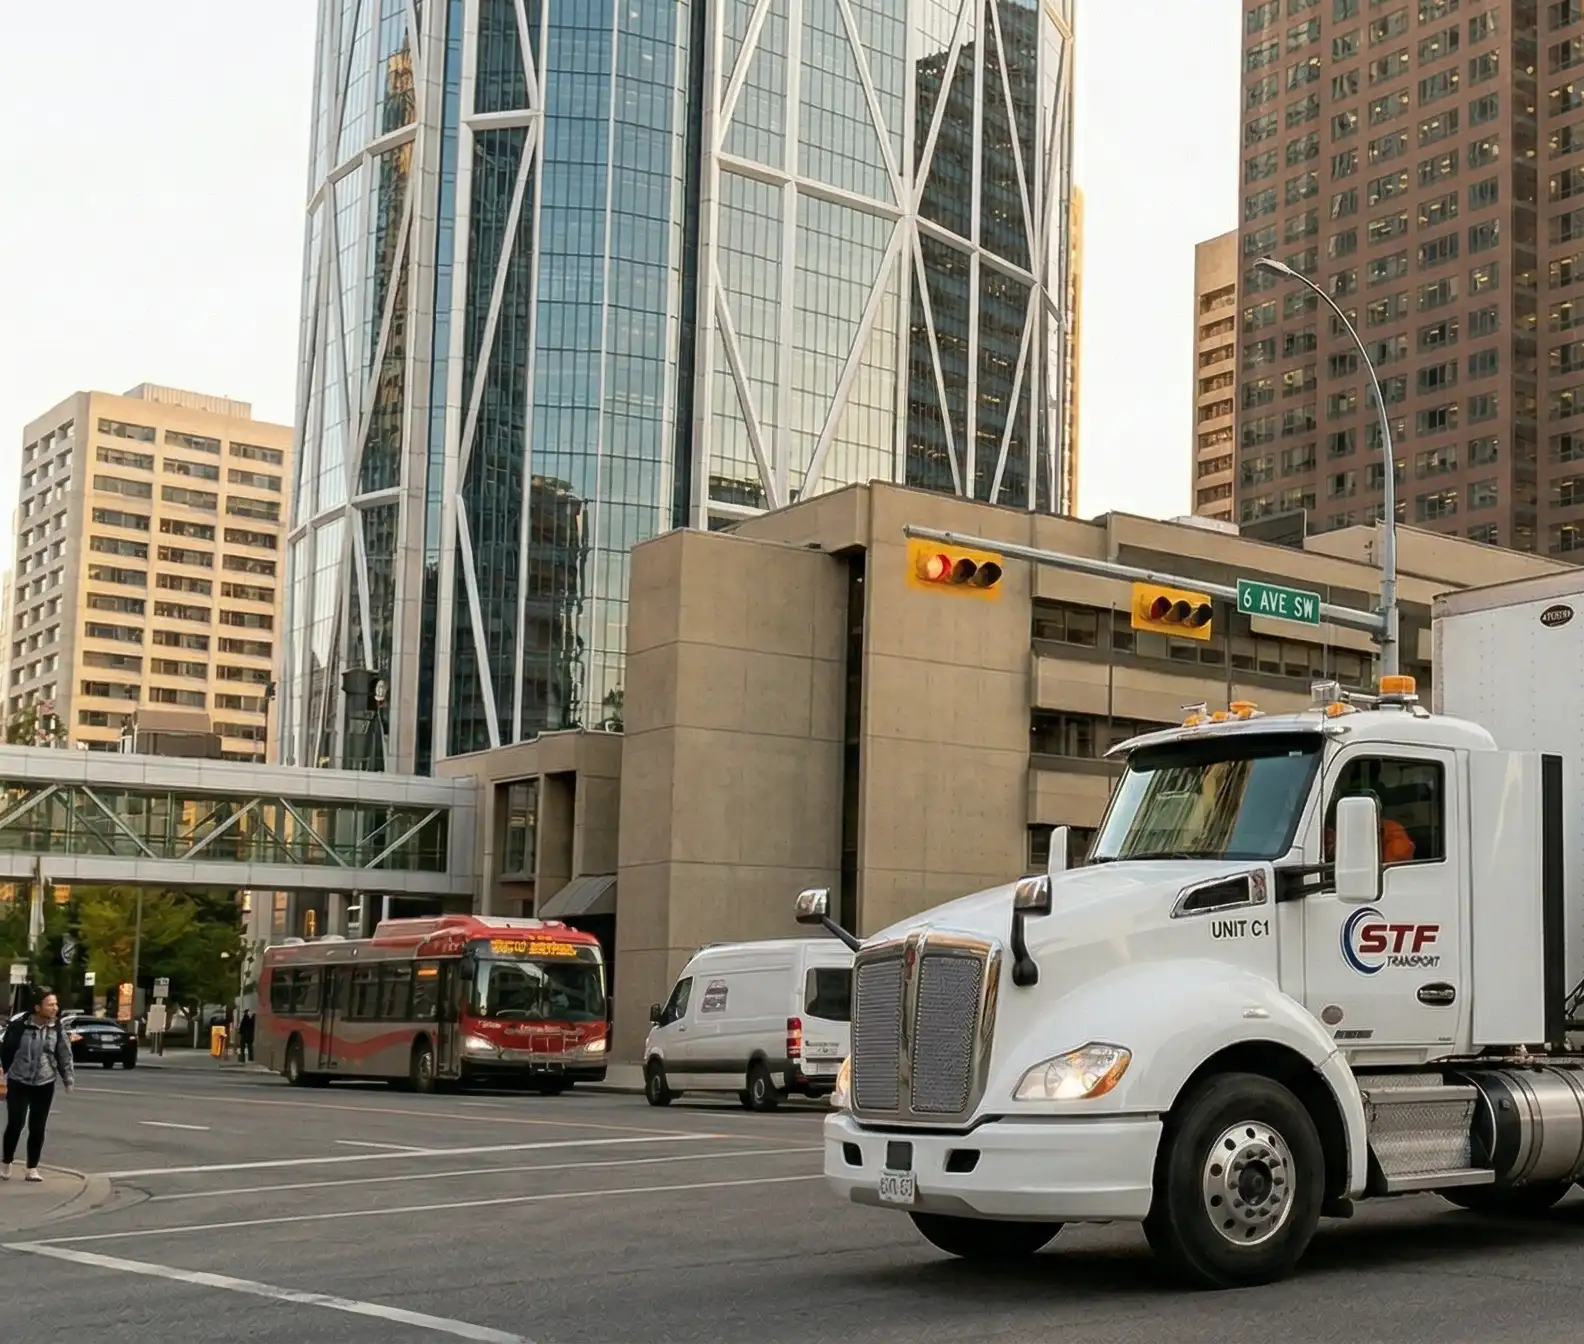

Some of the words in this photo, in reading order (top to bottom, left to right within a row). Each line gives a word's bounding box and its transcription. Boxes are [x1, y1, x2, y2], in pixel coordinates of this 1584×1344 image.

[1243, 588, 1252, 608] 6
[1260, 590, 1287, 614] AVE
[1294, 597, 1313, 619] SW
[1212, 920, 1247, 938] UNIT
[1252, 920, 1270, 937] C1
[1359, 924, 1439, 953] STF
